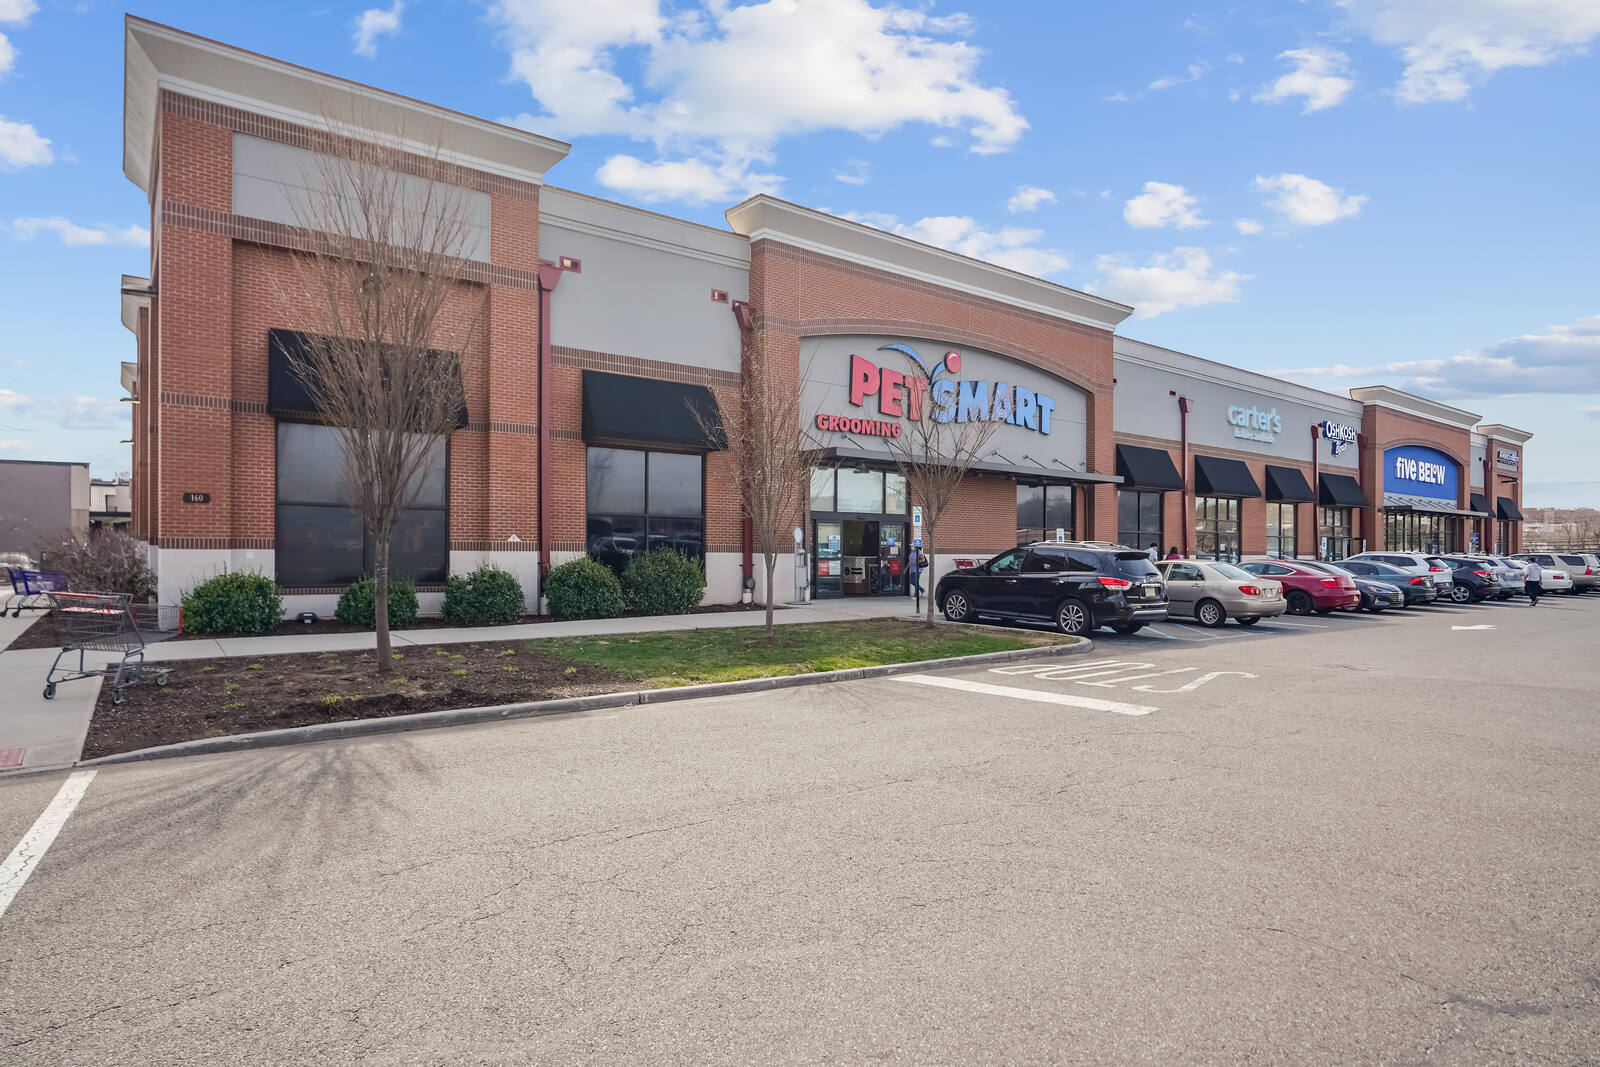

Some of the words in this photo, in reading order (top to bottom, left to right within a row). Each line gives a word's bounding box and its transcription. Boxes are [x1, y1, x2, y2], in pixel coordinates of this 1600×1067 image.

[815, 413, 902, 438] GROOMING
[1227, 405, 1281, 433] carter's
[1326, 420, 1356, 441] OSHKOSH
[1396, 456, 1417, 480] five
[1418, 461, 1445, 485] BELOW
[191, 494, 204, 502] 160
[988, 660, 1259, 693] STOP
